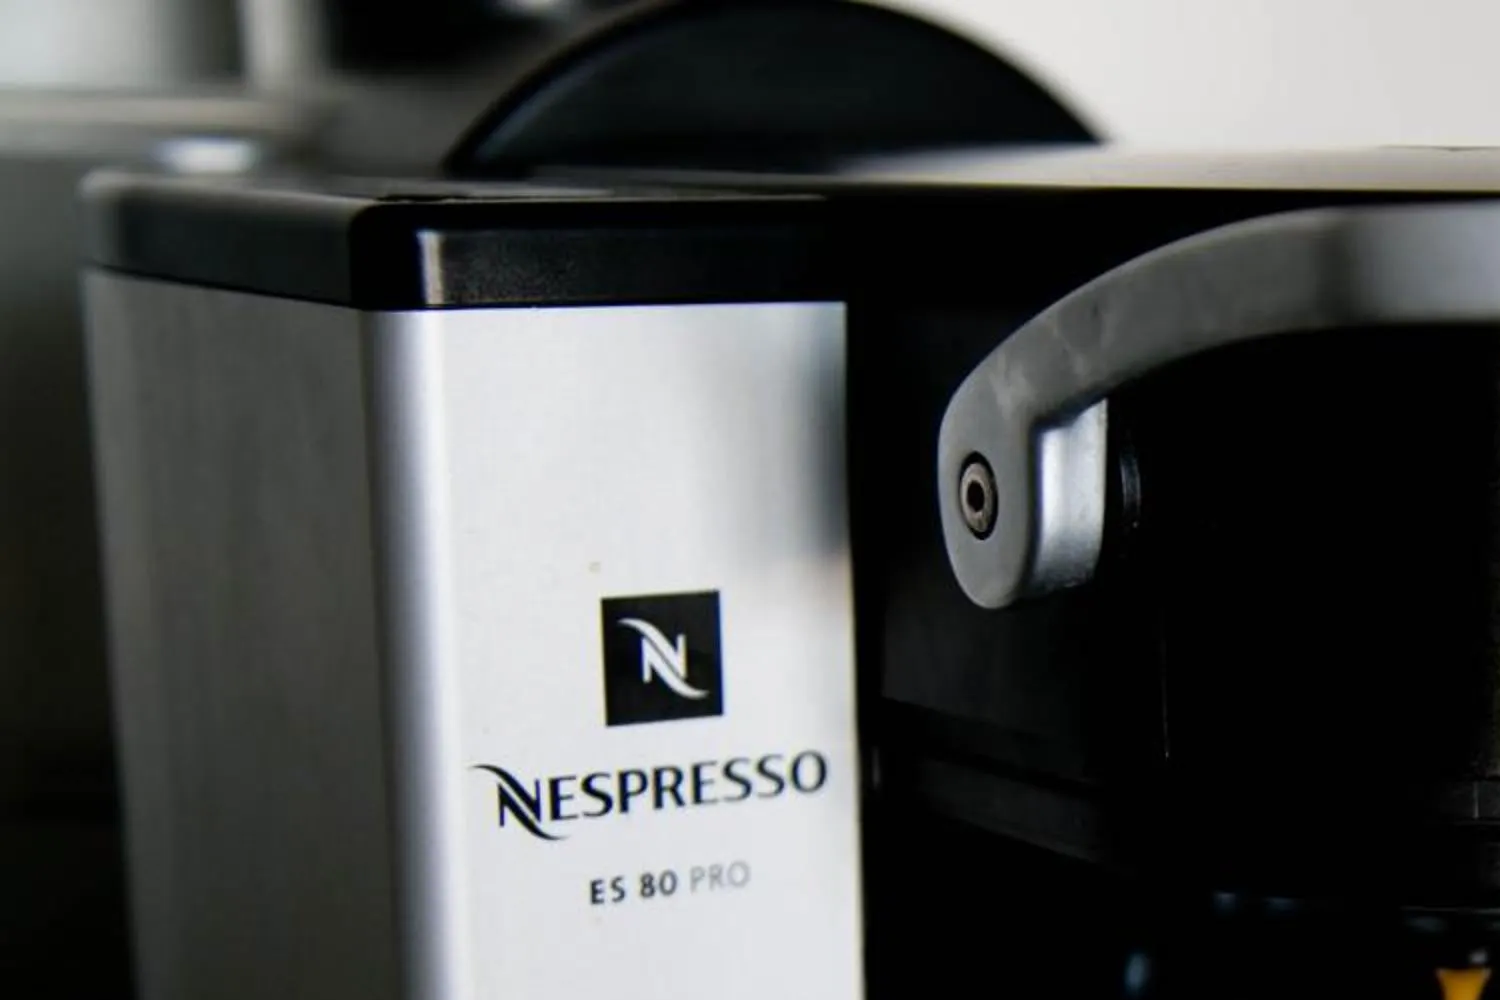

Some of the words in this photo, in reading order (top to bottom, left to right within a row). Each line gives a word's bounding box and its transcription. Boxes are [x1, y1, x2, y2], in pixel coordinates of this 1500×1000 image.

[616, 617, 711, 699] N
[468, 749, 829, 841] NESPRESSO
[589, 875, 626, 905] ES
[639, 869, 679, 898] 80
[688, 859, 752, 893] PRO
